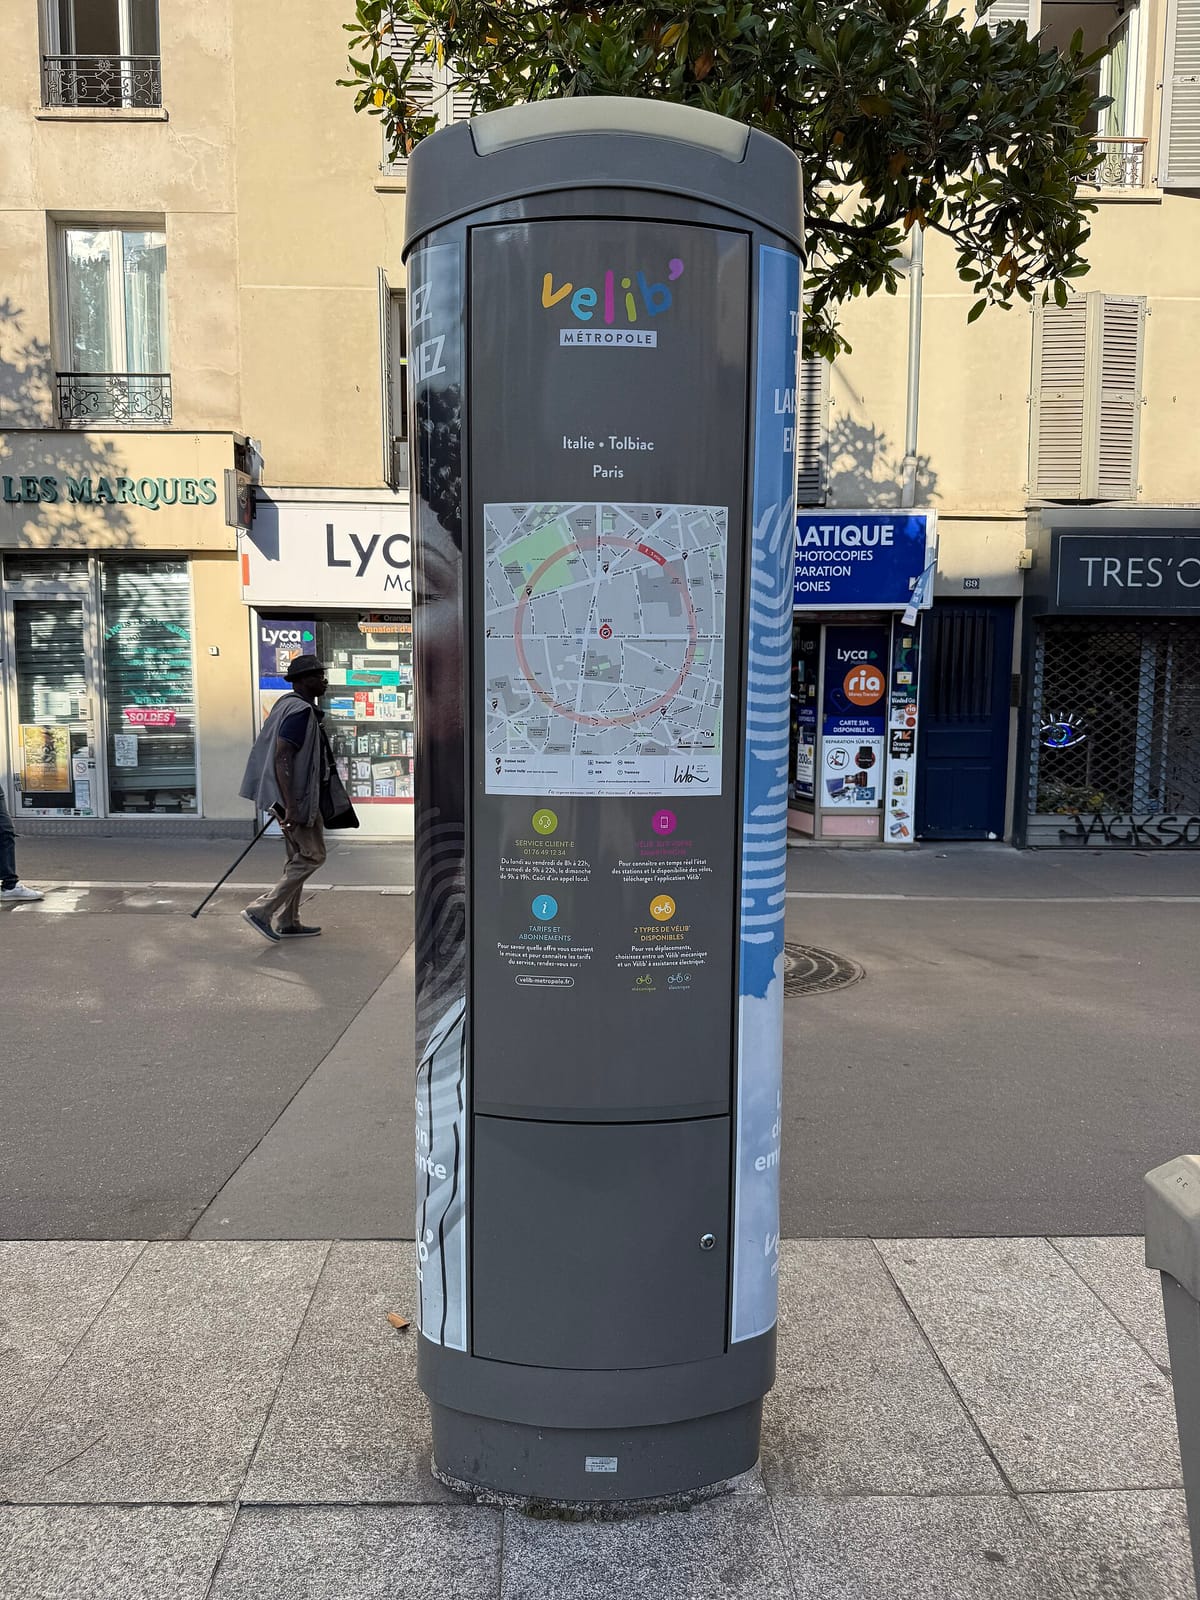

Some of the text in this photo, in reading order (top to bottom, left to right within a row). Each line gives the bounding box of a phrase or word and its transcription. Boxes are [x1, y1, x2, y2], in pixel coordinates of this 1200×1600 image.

[564, 331, 652, 344] MÉTROPOLE
[563, 435, 654, 450] Italie Tolbiac
[593, 464, 624, 478] Paris
[2, 476, 217, 511] LES MARQUES
[326, 524, 410, 577] Lyc
[965, 580, 978, 588] 69
[384, 614, 410, 622] Orange
[262, 627, 301, 644] Lyca
[837, 648, 868, 662] Lyca
[848, 670, 880, 690] ria
[130, 712, 170, 723] SOLDES
[515, 840, 543, 848] SERVICE
[656, 867, 688, 876] disponibilité
[654, 876, 686, 884] l'application
[518, 934, 572, 942] ABONNEMENTS
[640, 934, 684, 942] DISPONIBLES
[520, 976, 570, 985] velib-metropole.fr
